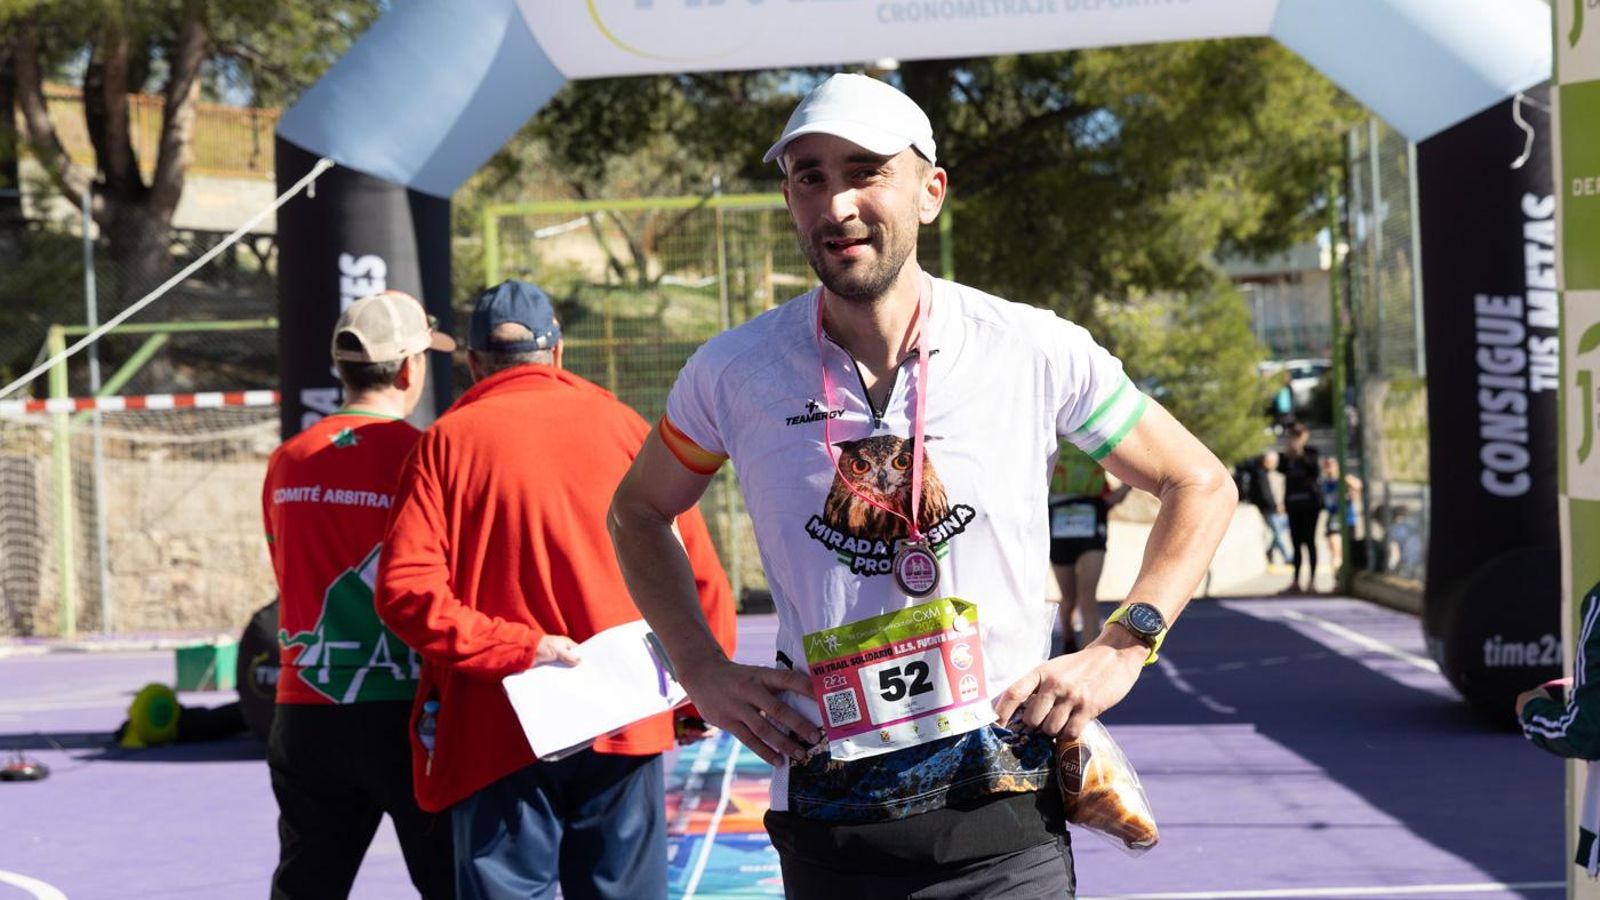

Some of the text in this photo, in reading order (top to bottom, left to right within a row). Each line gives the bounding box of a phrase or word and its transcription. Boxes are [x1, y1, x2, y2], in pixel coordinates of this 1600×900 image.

[1521, 192, 1559, 392] TUS METAS
[1475, 293, 1531, 497] CONSIGUE
[785, 409, 846, 426] TEAMERGY
[273, 484, 395, 509] COMITÉ ARBITRA
[826, 659, 849, 674] TRAIL
[878, 660, 934, 702] 52
